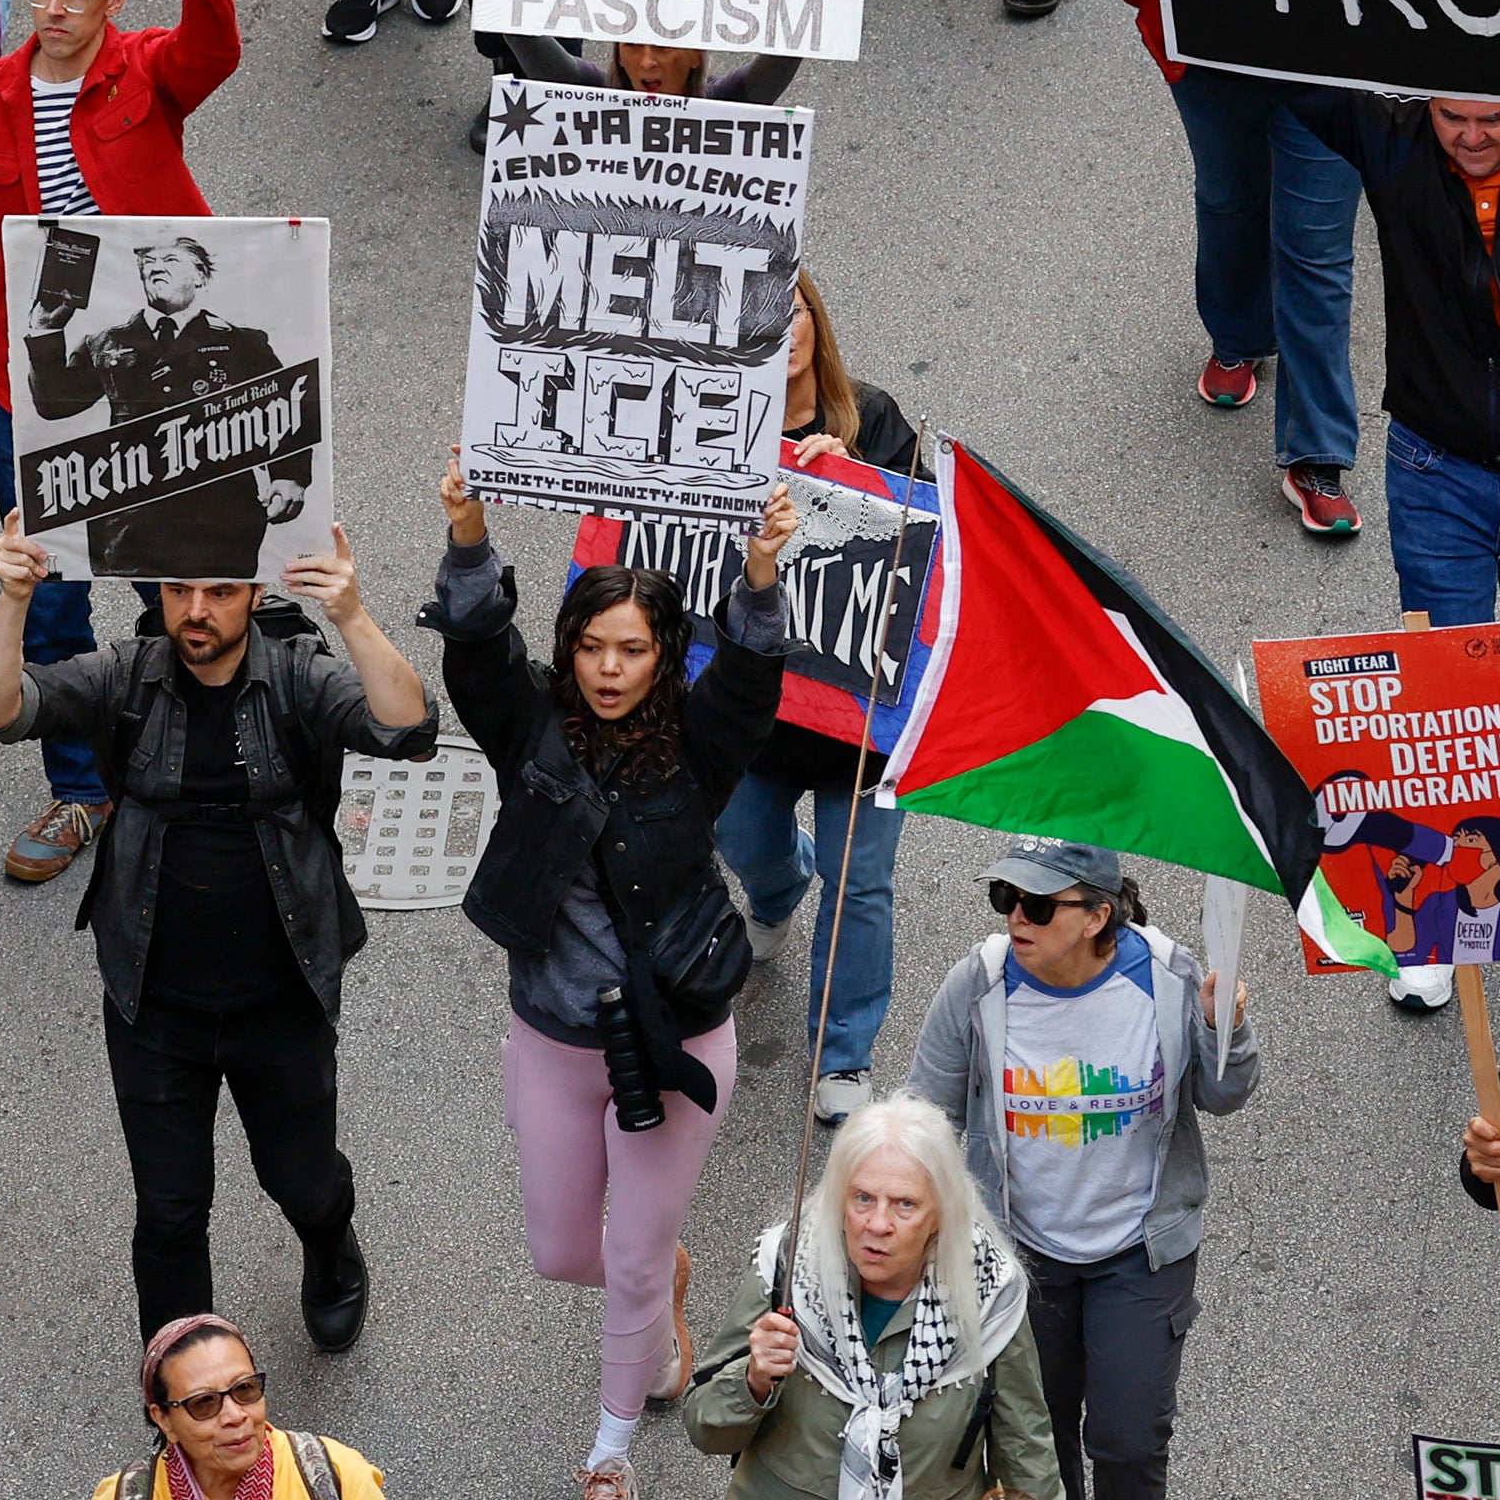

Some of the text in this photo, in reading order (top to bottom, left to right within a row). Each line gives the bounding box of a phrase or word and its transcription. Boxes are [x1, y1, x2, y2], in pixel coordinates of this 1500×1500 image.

[553, 109, 805, 160] ¡YA BASTA!
[586, 159, 628, 174] THE
[633, 157, 797, 207] VIOLENCE!
[503, 224, 770, 348] MELT
[203, 381, 278, 418] The Turd Reich
[495, 348, 771, 474] ICE!
[37, 375, 308, 519] Mein Trumpf
[1009, 1090, 1154, 1110] LOVE & RESIST
